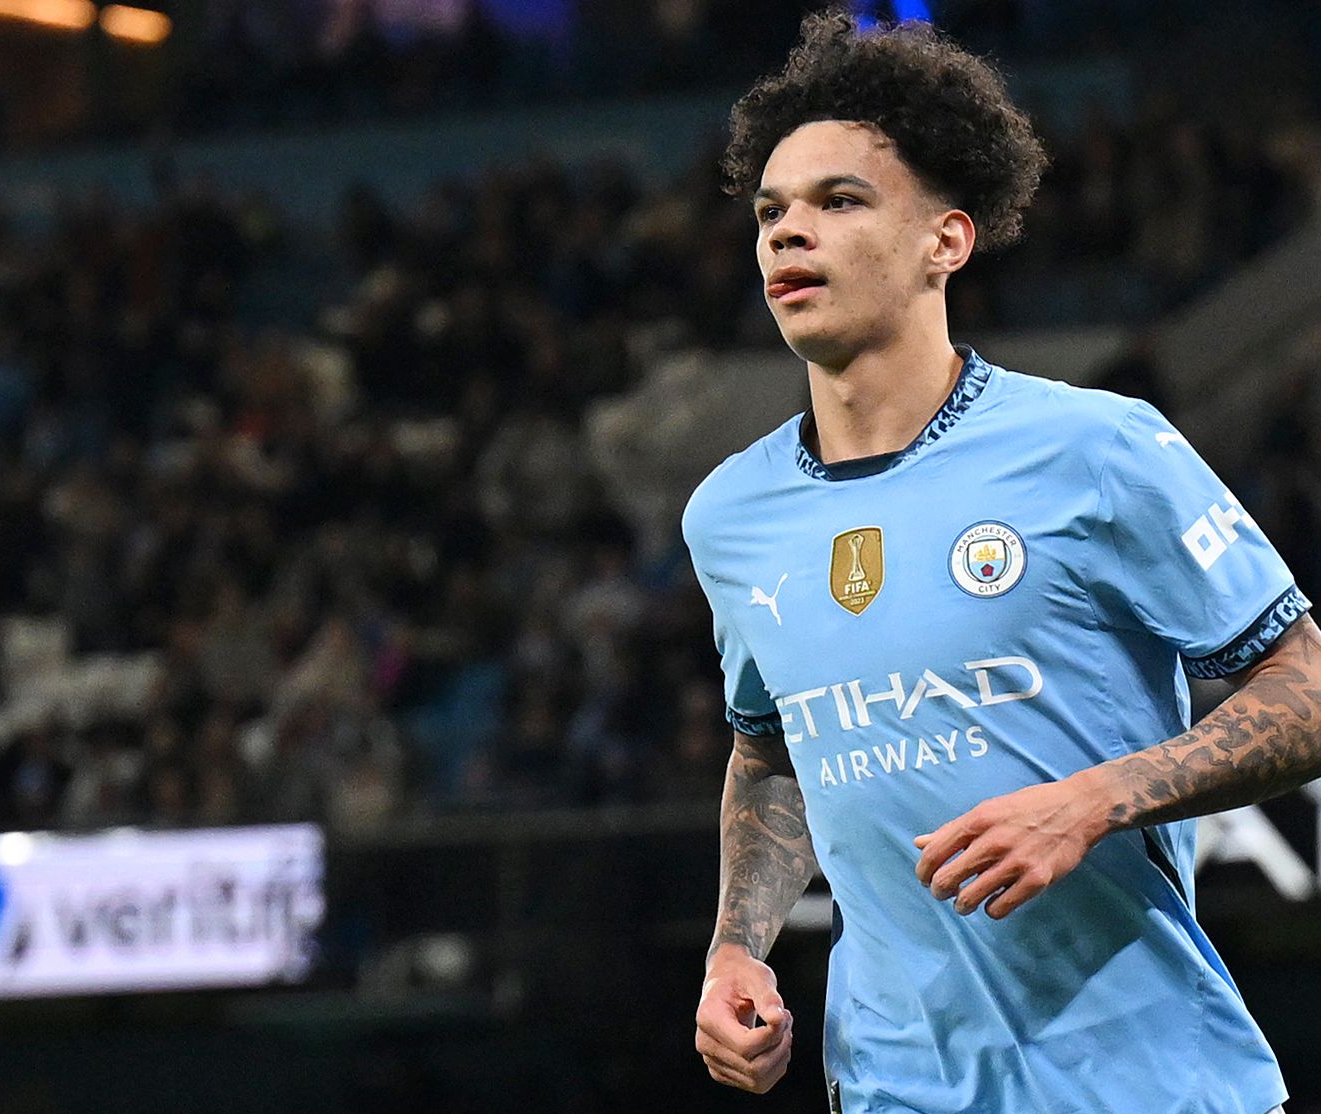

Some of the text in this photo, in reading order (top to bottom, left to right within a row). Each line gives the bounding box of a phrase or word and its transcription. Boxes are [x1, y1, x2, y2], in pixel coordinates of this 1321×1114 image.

[957, 527, 1017, 553] MANCHESTER
[844, 580, 870, 595] FIFA
[978, 584, 1001, 593] CITY
[774, 656, 1043, 743] ETIHAD
[820, 726, 988, 787] AIRWAYS
